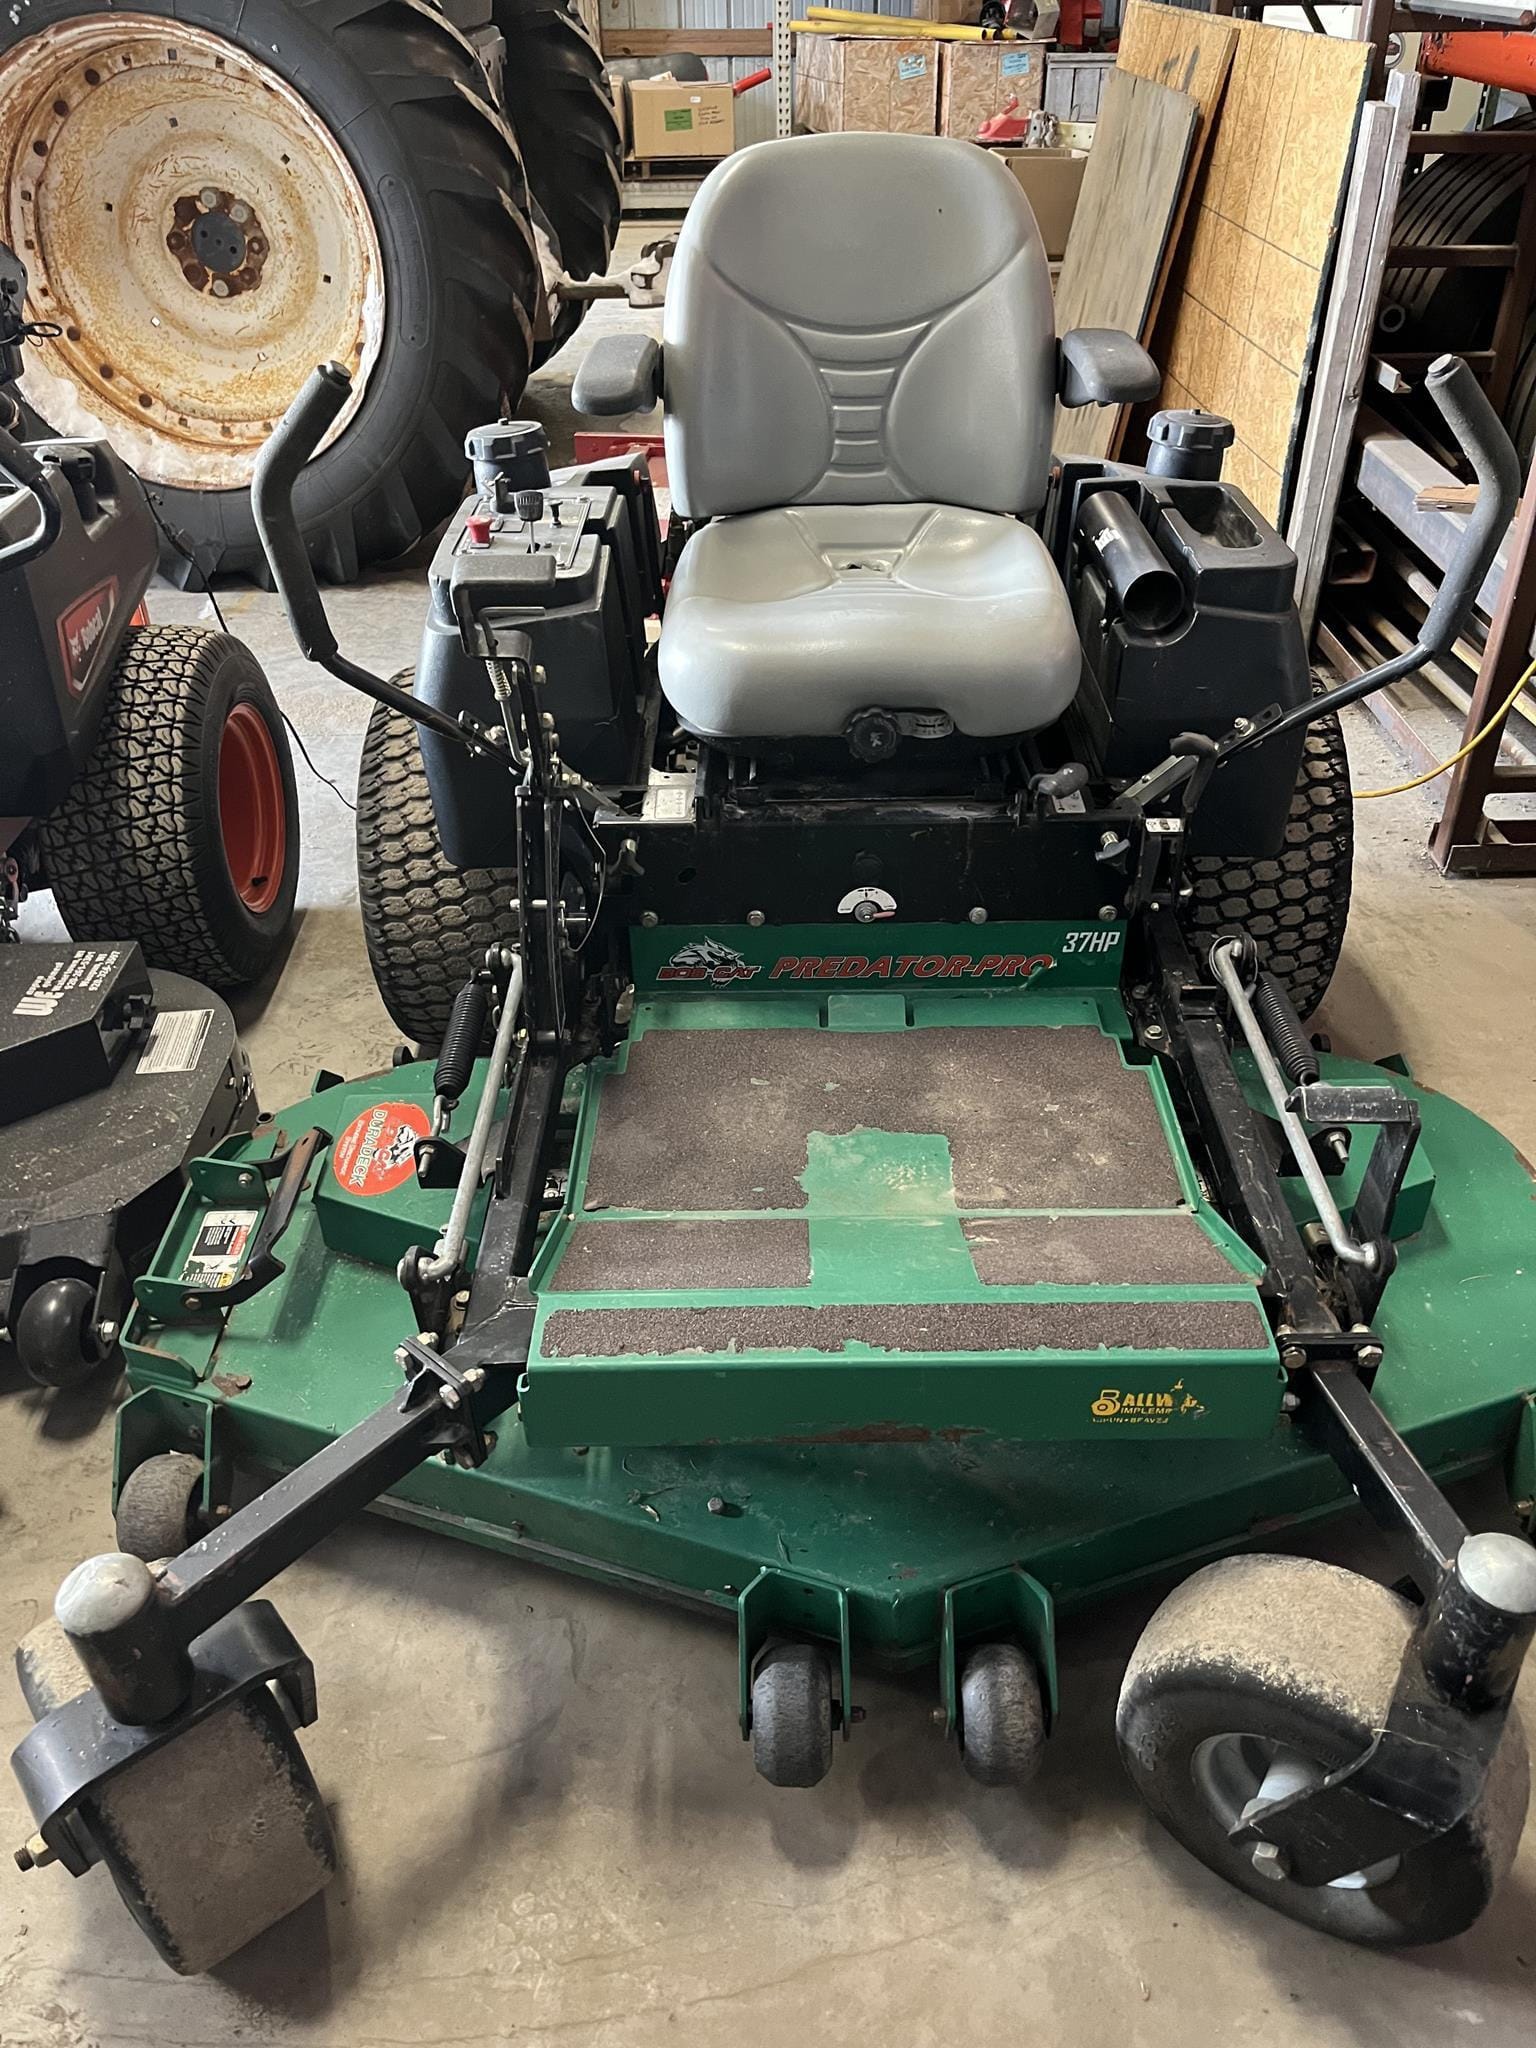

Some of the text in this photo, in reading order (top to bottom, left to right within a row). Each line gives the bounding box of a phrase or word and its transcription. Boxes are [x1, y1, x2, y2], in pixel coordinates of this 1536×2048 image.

[1062, 931, 1121, 953] 37HP
[768, 955, 1056, 979] PREDATOR-PRO
[348, 1109, 388, 1187] DURADECK
